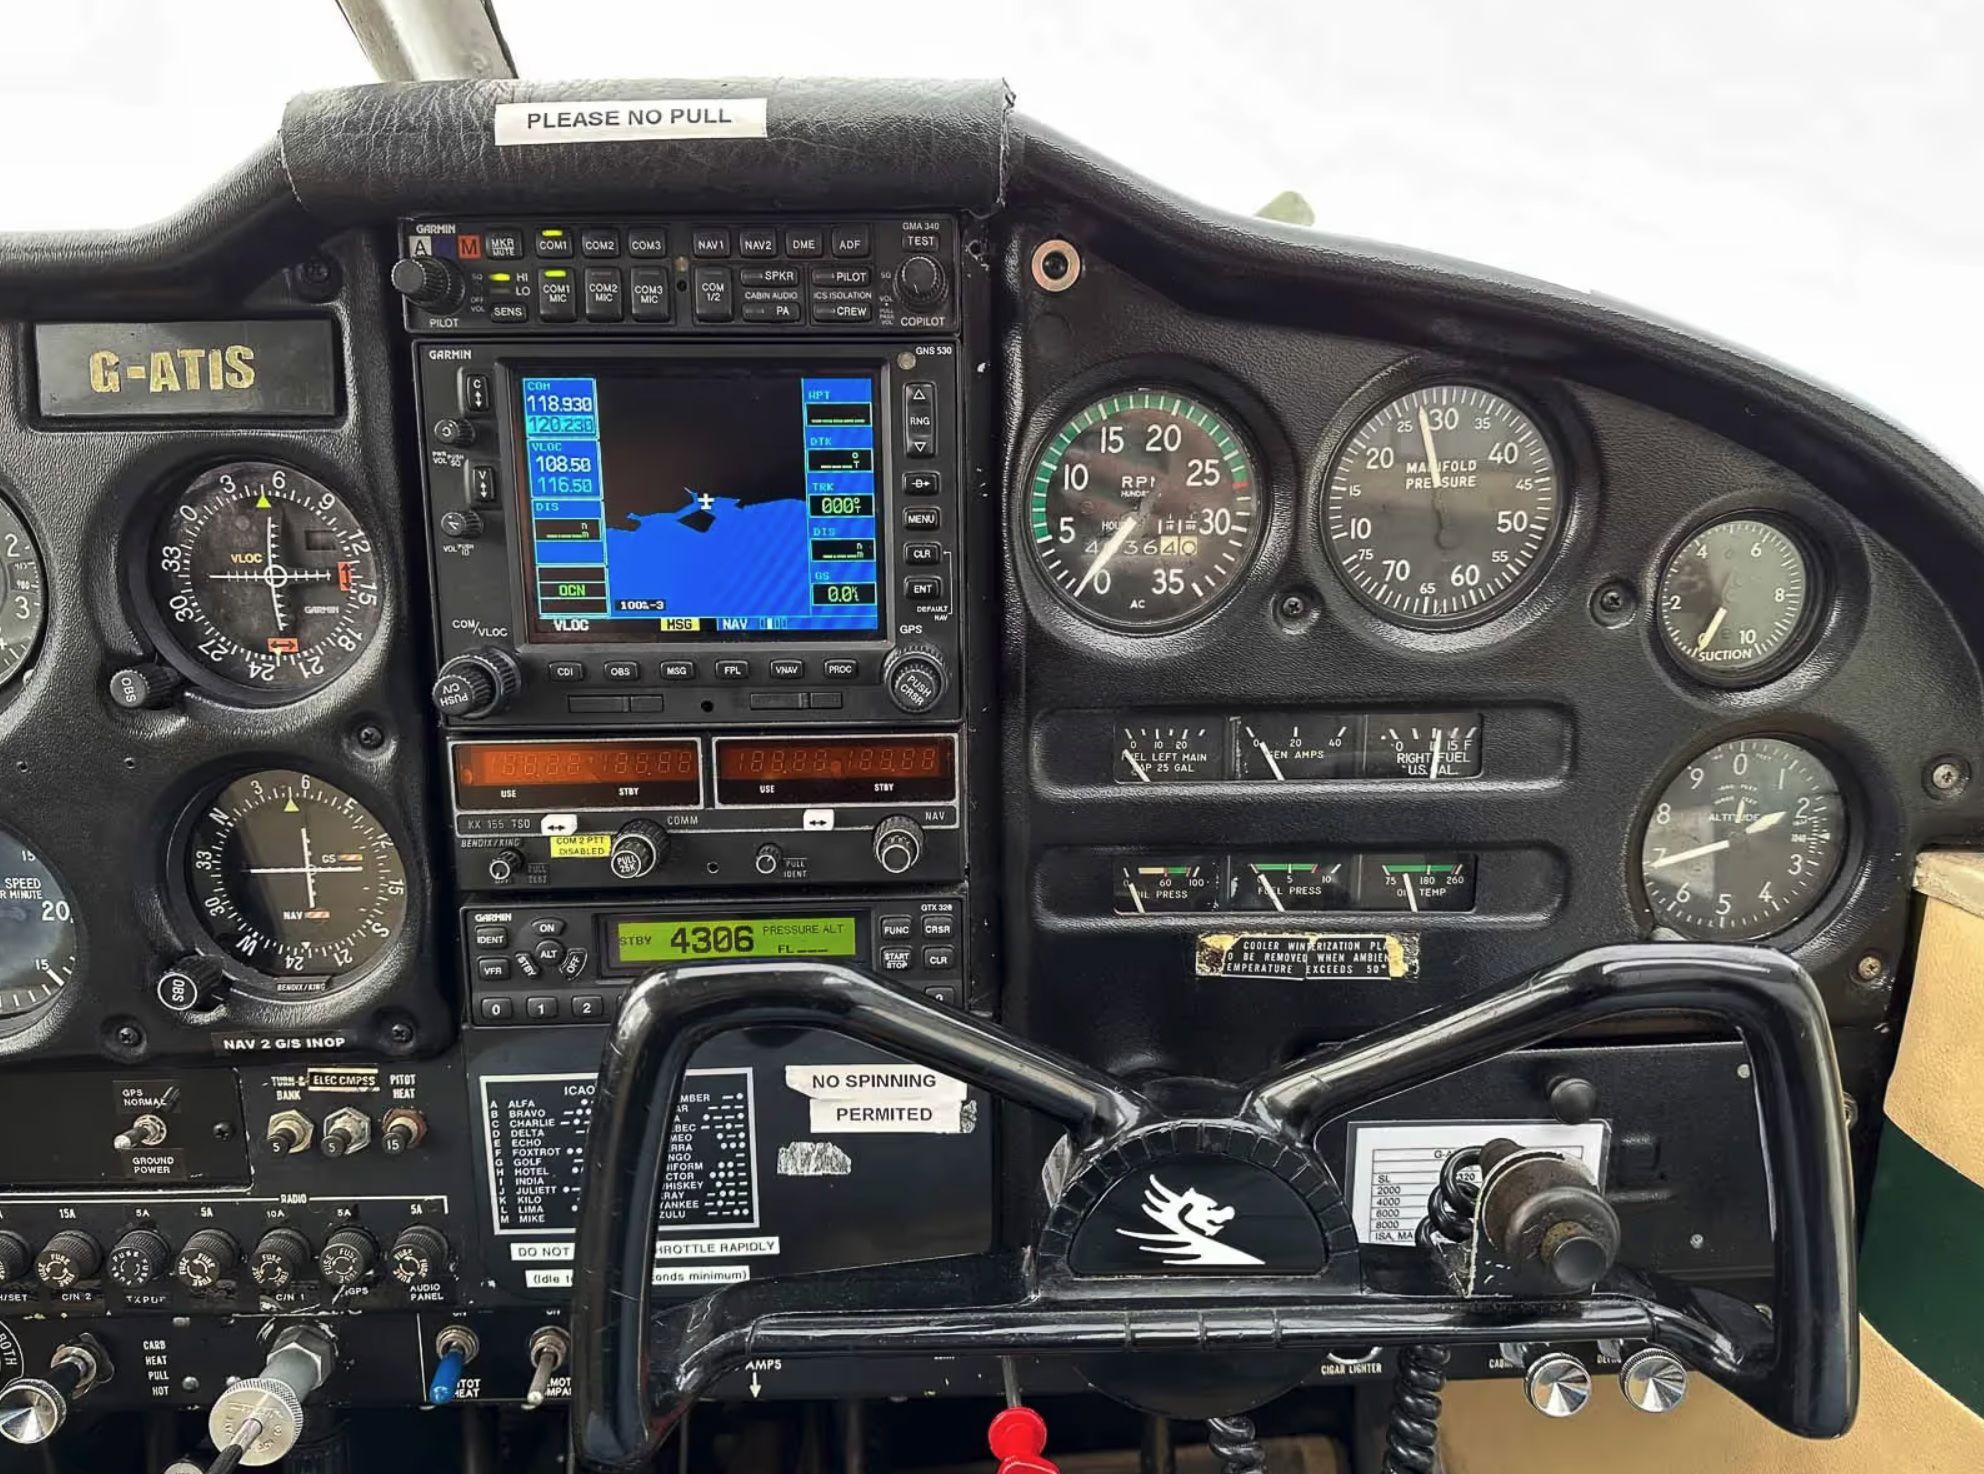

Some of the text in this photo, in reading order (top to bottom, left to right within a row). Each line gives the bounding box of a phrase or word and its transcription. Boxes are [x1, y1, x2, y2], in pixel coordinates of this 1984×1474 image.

[527, 108, 732, 129] PLEASE NO PULL
[416, 225, 456, 233] GARMIN
[902, 222, 939, 230] GMA 340
[632, 241, 661, 250] COM3
[698, 241, 724, 249] NAV1
[745, 241, 772, 250] NAV2
[793, 240, 815, 249] DME
[839, 241, 860, 249] ADF
[908, 237, 934, 246] TEST
[765, 271, 794, 281] SPKR
[836, 272, 866, 282] PILOT
[543, 285, 570, 293] COM1
[589, 284, 617, 292] COM2
[634, 286, 663, 295] COM3
[702, 283, 724, 292] COM
[829, 291, 872, 299] ISOLATION
[494, 307, 522, 317] SENS
[836, 307, 866, 316] CREW
[430, 319, 459, 328] PILOT
[901, 317, 945, 326] COPILOT
[429, 350, 472, 359] GARMIN
[916, 347, 934, 355] GNS
[89, 344, 255, 393] G-ATIS
[527, 396, 592, 412] 118.930
[910, 417, 930, 425] RNG
[1429, 408, 1459, 430] 30
[529, 417, 594, 432] 120.230
[1101, 427, 1125, 453] 15
[1146, 424, 1181, 451] 20
[1489, 442, 1518, 464] 40
[1366, 447, 1394, 469] 20
[536, 456, 591, 472] 108.50
[1064, 464, 1088, 490] 10
[1186, 459, 1221, 486] 25
[538, 477, 592, 492] 116.50
[1406, 476, 1477, 489] PRESURE
[908, 515, 935, 523] MENU
[1200, 508, 1230, 535] 30
[1497, 511, 1527, 532] 50
[1060, 518, 1074, 543] 5
[1350, 518, 1371, 539] 10
[231, 554, 262, 563] VLOC
[1492, 551, 1508, 562] 55
[1382, 560, 1410, 581] 70
[1451, 564, 1480, 586] 60
[1152, 569, 1184, 594] 35
[1420, 583, 1436, 594] 65
[554, 620, 589, 631] VLOC
[723, 619, 747, 630] NAV
[900, 625, 922, 634] GPS
[1698, 649, 1751, 661] SUCTION
[1152, 753, 1206, 761] LEFT MAIN
[1397, 752, 1470, 763] RIGHT FUEL
[1157, 764, 1194, 772] 25 GAL
[1733, 753, 1748, 775] 0
[1690, 768, 1704, 789] 9
[1796, 798, 1810, 818] 2
[926, 811, 945, 820] NAV
[1656, 803, 1671, 824] 8
[468, 820, 481, 829] KX
[488, 820, 504, 829] 155
[668, 816, 698, 825] COMM
[557, 837, 576, 845] COM
[587, 836, 604, 844] PTT
[559, 847, 605, 855] DISABLED
[1788, 854, 1802, 875] 3
[5, 878, 41, 889] SPEED
[1676, 883, 1690, 902] 6
[1758, 882, 1772, 901] 4
[1716, 894, 1732, 914] 5
[42, 901, 70, 921] 20
[475, 913, 512, 922] GARMIN
[763, 924, 843, 935] PRESSURE ALT
[885, 926, 909, 934] FUNC
[925, 924, 950, 934] CRSR
[477, 936, 504, 944] IDENT
[620, 936, 651, 945] STBY
[670, 925, 755, 955] 4306
[1244, 942, 1279, 950] COOLER
[1243, 953, 1345, 963] BE REMOVED WHEN
[1306, 965, 1353, 974] EXCEEDS
[224, 1037, 345, 1049] NAV 2 G/S INOP
[314, 1076, 375, 1085] ELEC CMPSS
[812, 1074, 936, 1088] NO SPINNING
[564, 1085, 595, 1096] ICAO
[277, 1091, 301, 1100] BANK
[508, 1099, 535, 1108] ALFA
[509, 1109, 546, 1117] BRAVO
[837, 1108, 932, 1121] PERMITED
[510, 1118, 555, 1127] CHARLIE
[510, 1129, 544, 1138] DELTA
[512, 1138, 541, 1147] ECHO
[513, 1148, 560, 1156] FOXTROT
[133, 1157, 174, 1165] GROUND
[514, 1158, 542, 1166] GOLF
[134, 1166, 170, 1174] POWER
[514, 1167, 549, 1175] HOTEL
[516, 1177, 544, 1185] INDIA
[516, 1186, 556, 1195] JULIETT
[1376, 1186, 1400, 1194] 2000
[281, 1194, 306, 1204] RADIO
[518, 1195, 542, 1204] KILO
[1376, 1197, 1400, 1206] 4000
[59, 1209, 76, 1218] 15A
[519, 1205, 543, 1214] LIMA
[659, 1210, 685, 1218] ZULU
[1376, 1209, 1400, 1217] 6000
[519, 1215, 545, 1223] MIKE
[1376, 1220, 1399, 1229] 8000
[518, 1241, 775, 1257] DO NOT RAPIDLY
[689, 1270, 747, 1281] minimum)
[410, 1284, 440, 1292] AUDIO
[411, 1292, 443, 1300] PANEL
[0, 1333, 17, 1365] BOTH
[143, 1341, 166, 1350] CARB
[1321, 1363, 1382, 1375] CIGAR LIGHTER
[148, 1371, 169, 1380] PULL
